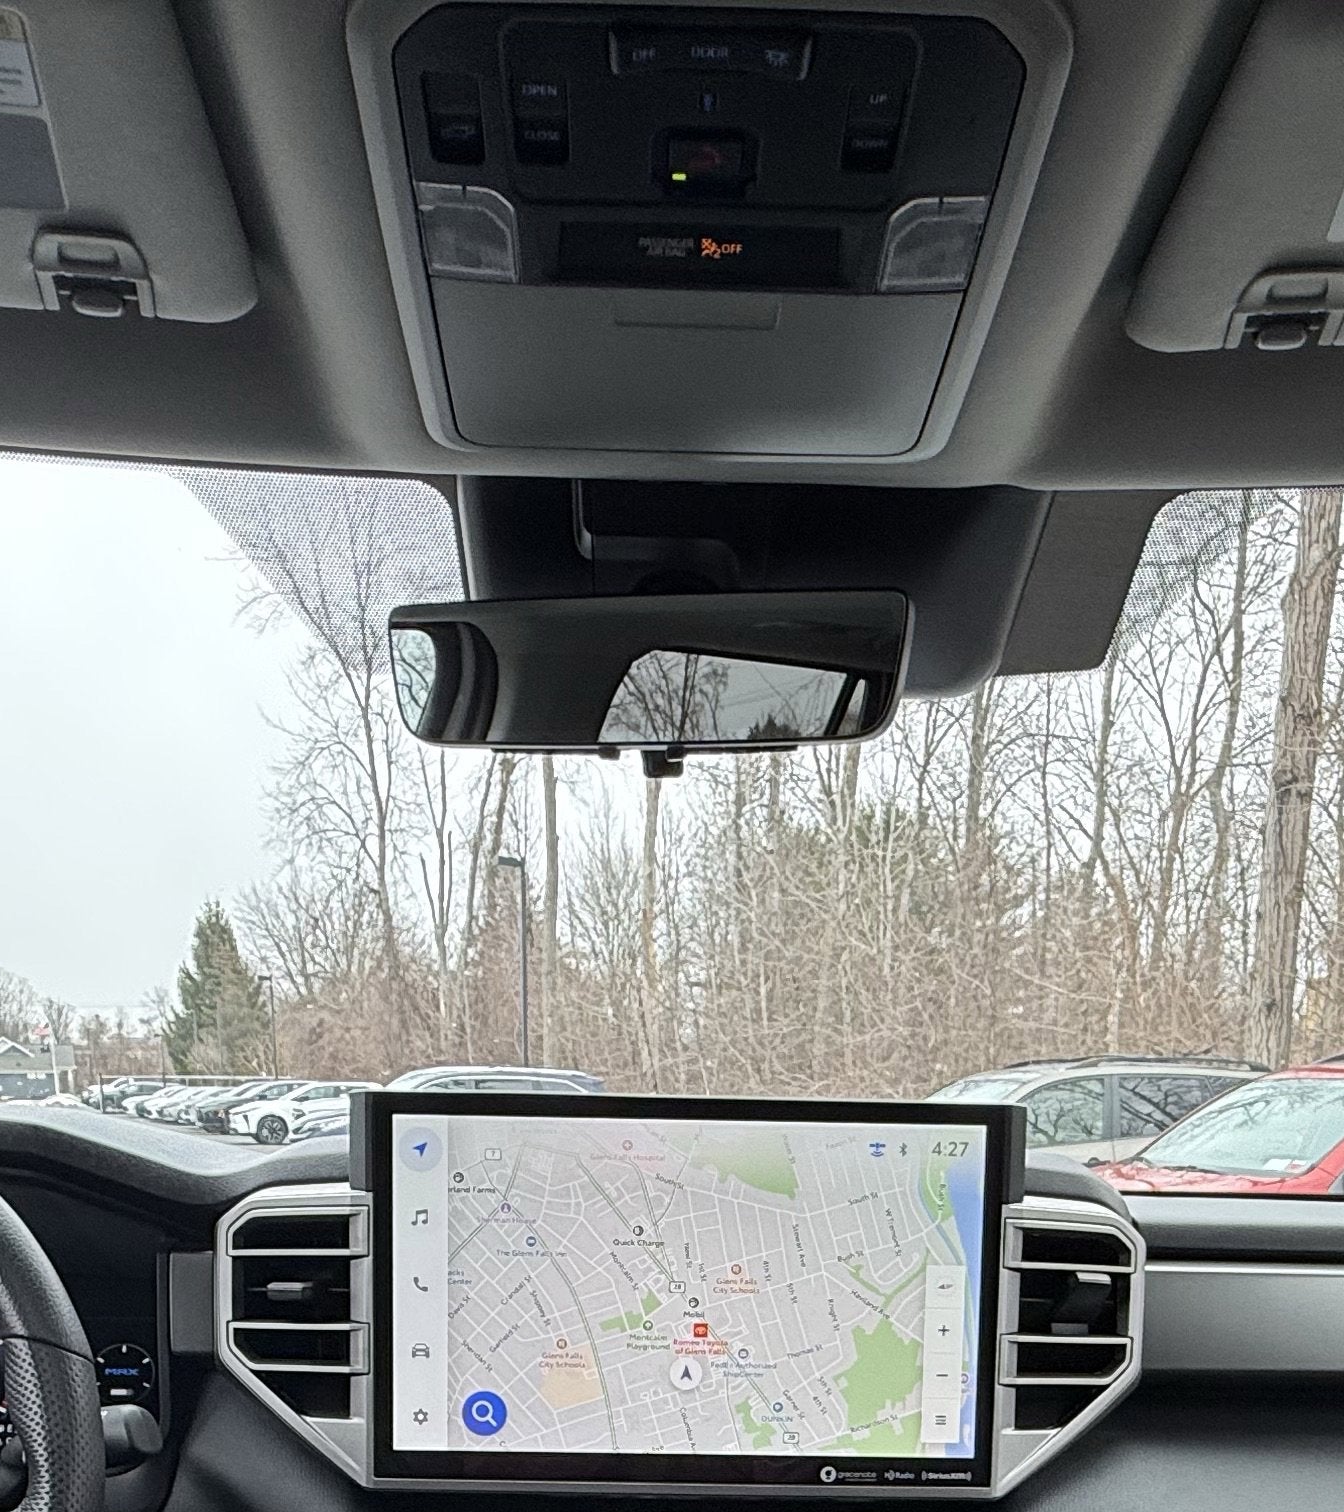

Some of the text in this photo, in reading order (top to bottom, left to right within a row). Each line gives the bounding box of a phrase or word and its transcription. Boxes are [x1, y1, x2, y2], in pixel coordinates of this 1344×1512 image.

[522, 84, 559, 97] OPEN
[721, 244, 744, 254] OFF
[931, 1141, 970, 1158] 4:27
[472, 1186, 497, 1194] Farms
[848, 1193, 869, 1207] South
[637, 1238, 665, 1248] Charge
[792, 1223, 807, 1268] Stewart Ave
[497, 1250, 510, 1258] The
[609, 1251, 635, 1284] Montcalm
[683, 1310, 705, 1319] Mobil
[626, 1343, 671, 1352] Playground
[702, 1338, 729, 1348] Toyota
[538, 1361, 555, 1370] City
[104, 1367, 139, 1376] MAX
[782, 1389, 802, 1412] Garner
[812, 1396, 823, 1410] 4th
[679, 1407, 693, 1443] Columbia
[837, 1470, 877, 1479] gracenote
[895, 1471, 915, 1480] Radio
